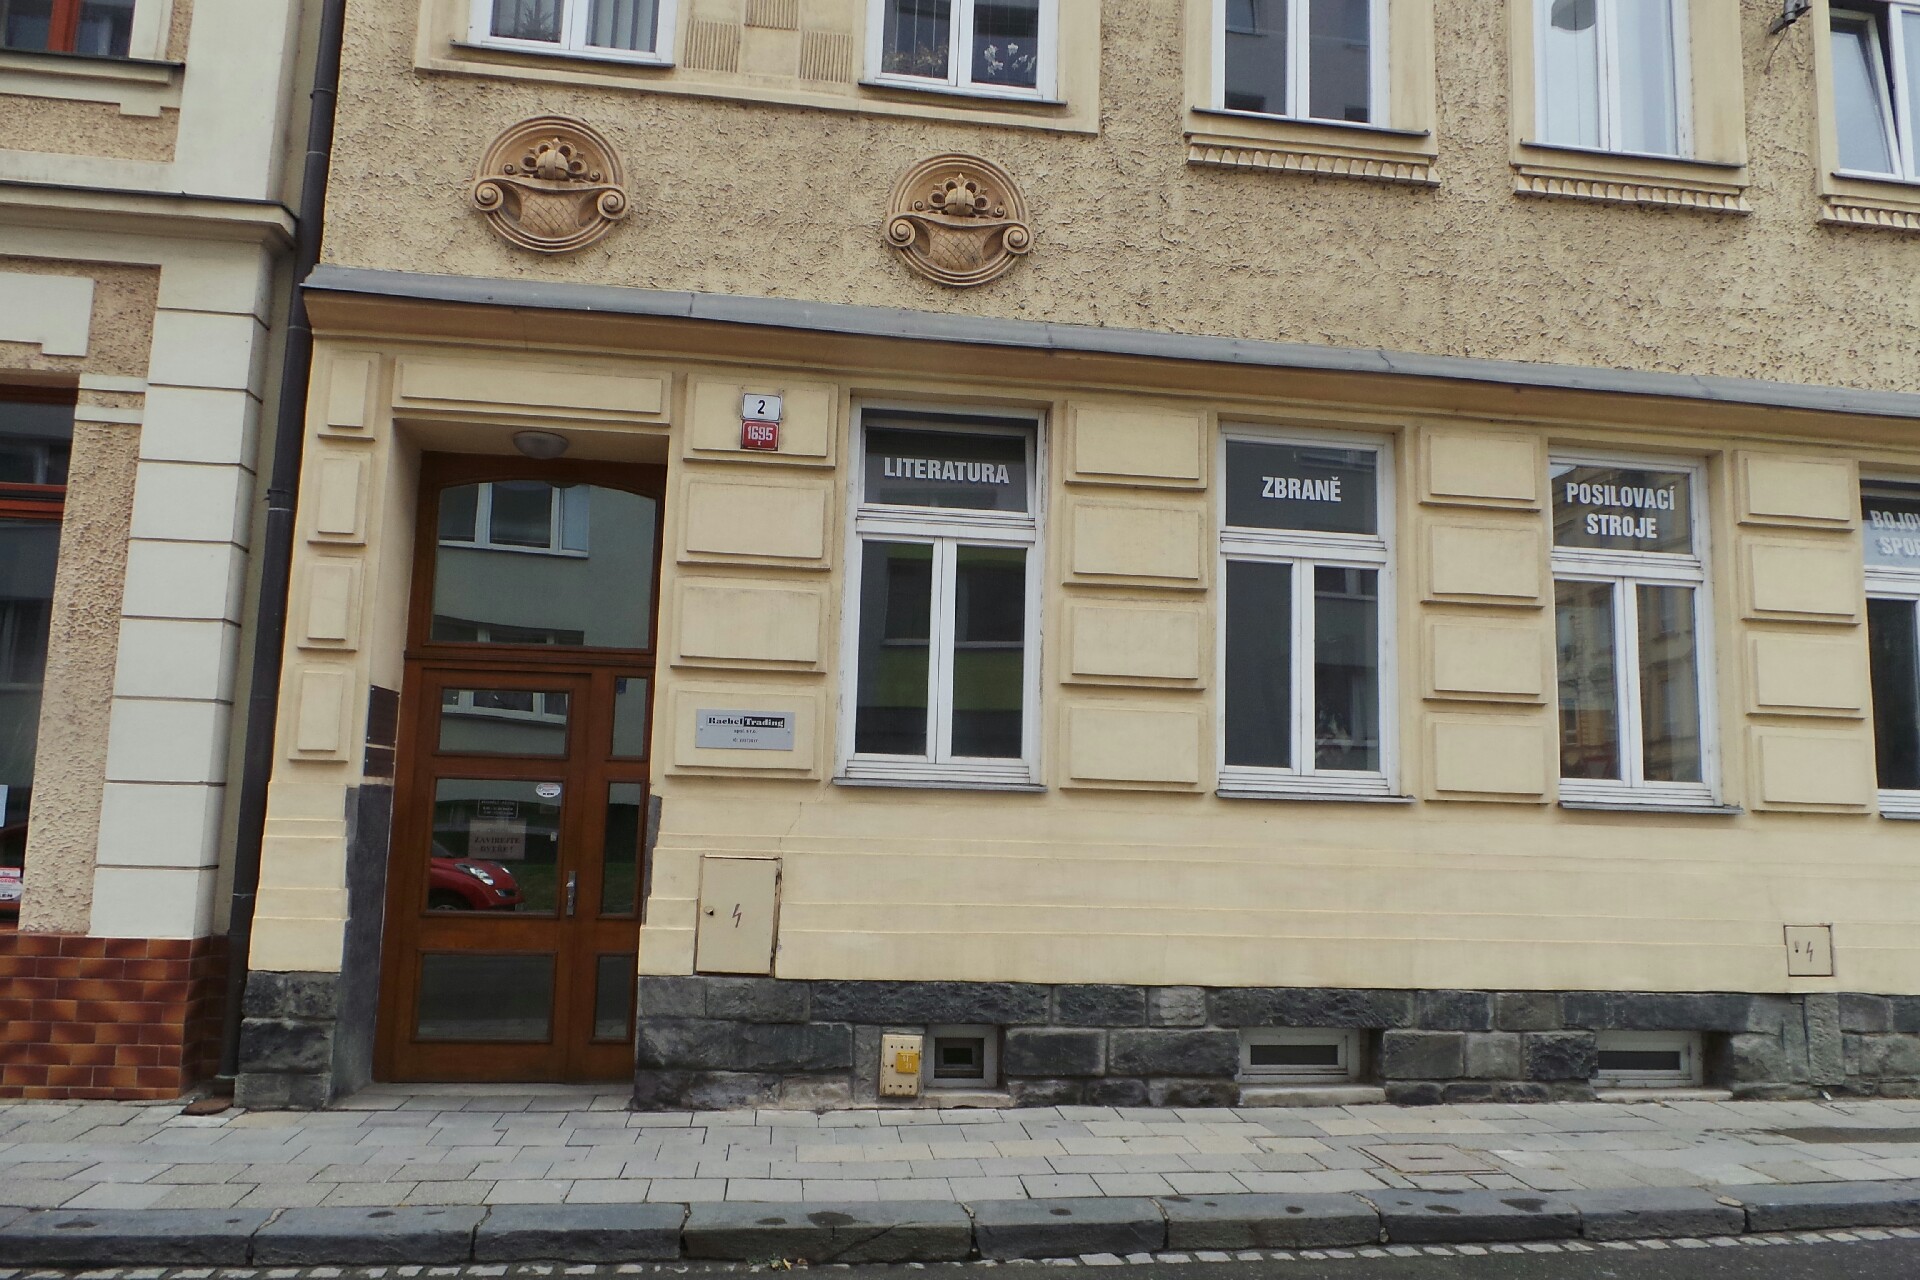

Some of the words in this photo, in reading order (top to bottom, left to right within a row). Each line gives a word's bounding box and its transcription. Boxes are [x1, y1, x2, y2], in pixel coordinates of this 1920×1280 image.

[757, 399, 766, 415] 2
[747, 425, 774, 441] 1695
[884, 457, 1010, 484] LITERATURA
[1262, 476, 1342, 502] ZBRANĚ
[1566, 482, 1675, 511] POSILOVACÍ
[1586, 513, 1658, 539] STROJE
[745, 717, 784, 728] Trading
